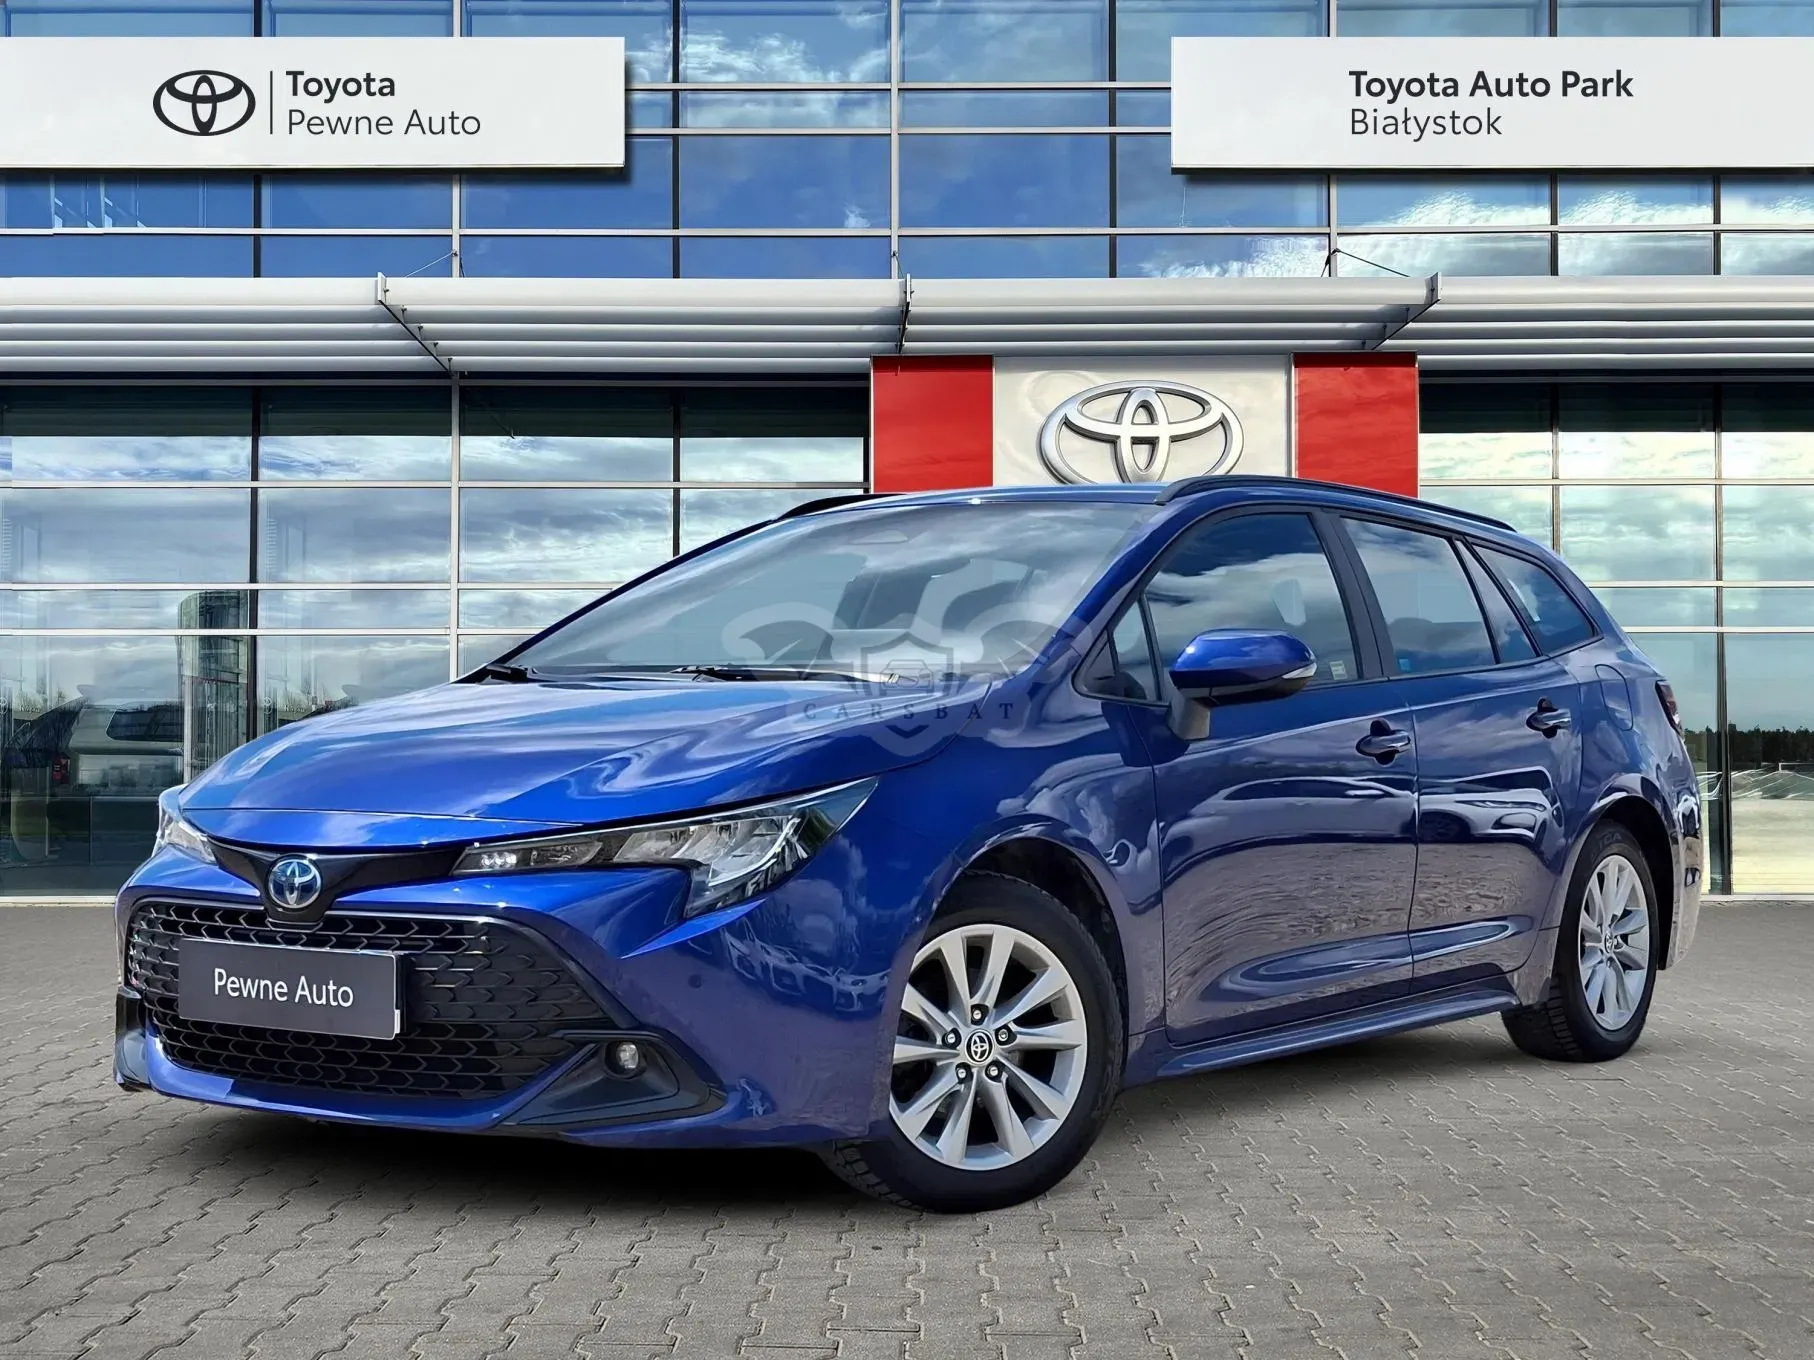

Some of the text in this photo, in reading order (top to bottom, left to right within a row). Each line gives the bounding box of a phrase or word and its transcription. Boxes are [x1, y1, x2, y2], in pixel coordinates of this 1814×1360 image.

[285, 70, 395, 104] Toyota
[1348, 69, 1634, 105] Toyota Auto Park
[288, 108, 481, 136] Pewne Auto
[1351, 106, 1503, 143] Białystok
[214, 967, 354, 1008] Pewne Auto
